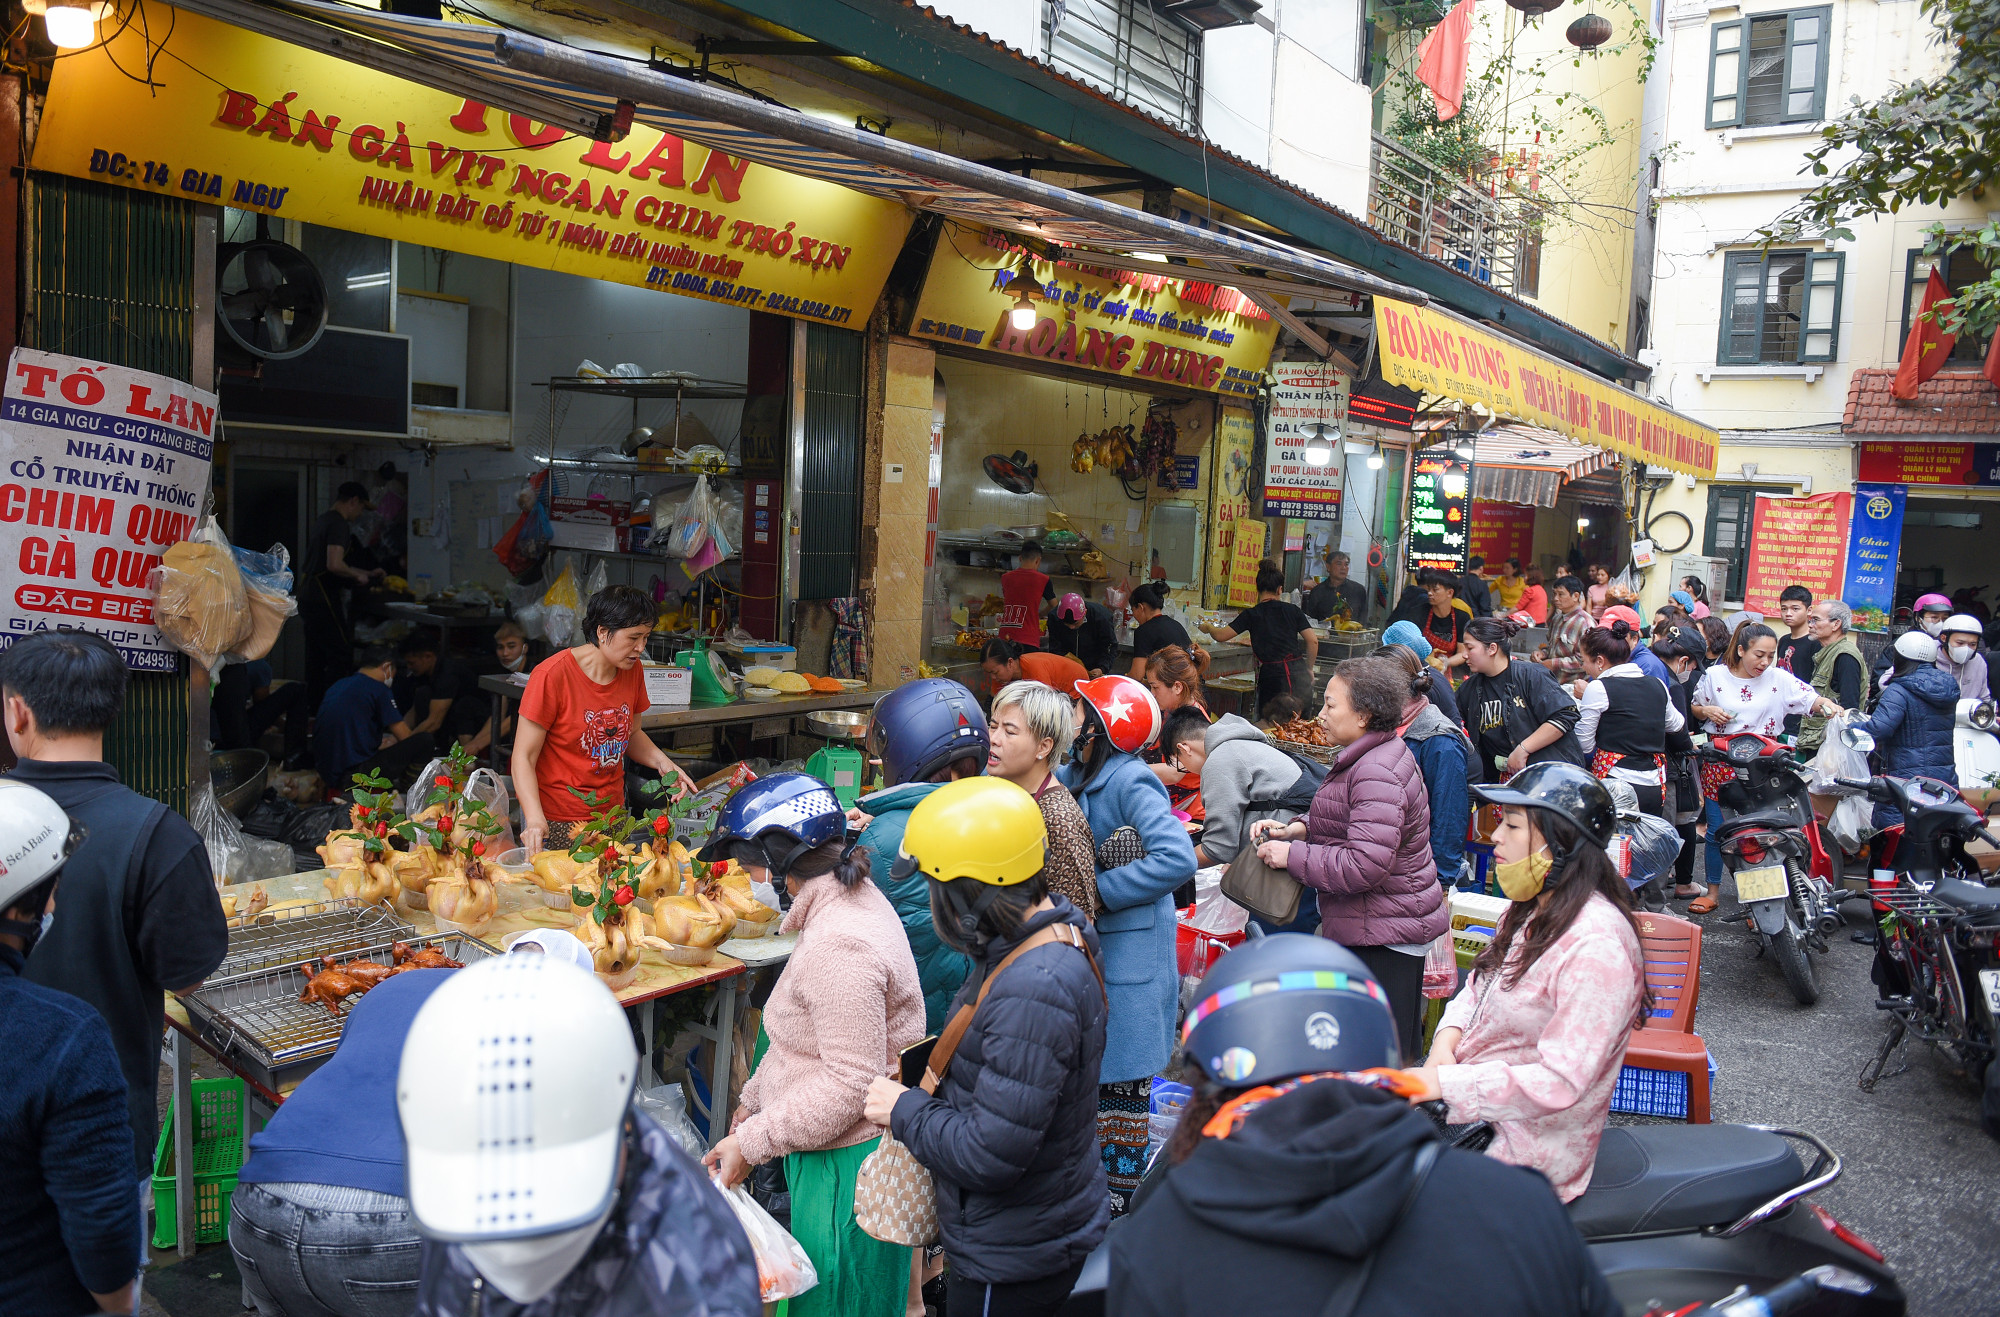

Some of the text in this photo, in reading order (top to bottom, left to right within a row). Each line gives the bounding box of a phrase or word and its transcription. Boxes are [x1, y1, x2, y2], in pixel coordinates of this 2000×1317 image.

[89, 148, 290, 211] ĐC: 14 GIA NGƯ
[219, 89, 852, 272] BÁN GÀ VỊT NGAN CHIM THỎ XỊN
[359, 175, 433, 212] NHẬN
[483, 200, 517, 229] CỖ
[517, 210, 550, 237] TỪ
[548, 219, 562, 240] 1
[561, 221, 610, 252] MÓN
[608, 231, 649, 259] ĐẾN
[647, 242, 700, 272] NHIỀU
[647, 265, 672, 286] ĐT:
[1103, 299, 1131, 321] một
[1132, 307, 1157, 326] món
[998, 307, 1225, 390] HOÀNG DUNG
[1383, 306, 1511, 390] HOÀNG DUNG
[1408, 366, 1418, 379] 14
[16, 362, 215, 438] TỐ LAN
[9, 403, 28, 420] 14
[32, 406, 60, 430] GIA
[64, 411, 103, 436] NGƯ
[114, 422, 148, 443] CHỢ
[150, 428, 183, 450] HÀNG
[1274, 421, 1291, 433] GÀ
[1274, 437, 1305, 448] CHIM
[66, 439, 177, 476] NHẬN ĐẶT
[1281, 450, 1296, 462] GÀ
[10, 455, 197, 508] CỖ TRUYỀN THỐNG
[1270, 464, 1340, 478] VỊT QUAY LẠNG SƠN
[1288, 476, 1306, 486] CÁC
[0, 483, 198, 547] CHIM QUAY
[1280, 509, 1302, 517] 0912
[1281, 501, 1302, 511] 0978
[1303, 504, 1324, 512] 5555
[1859, 536, 1890, 548] Chào
[18, 534, 164, 590] GÀ QUA
[1854, 575, 1884, 585] 2023
[20, 589, 93, 614] ĐẶC
[142, 628, 164, 647] LÝ
[131, 650, 177, 675] 7649515
[667, 672, 683, 680] 600
[591, 740, 630, 758] KENZO
